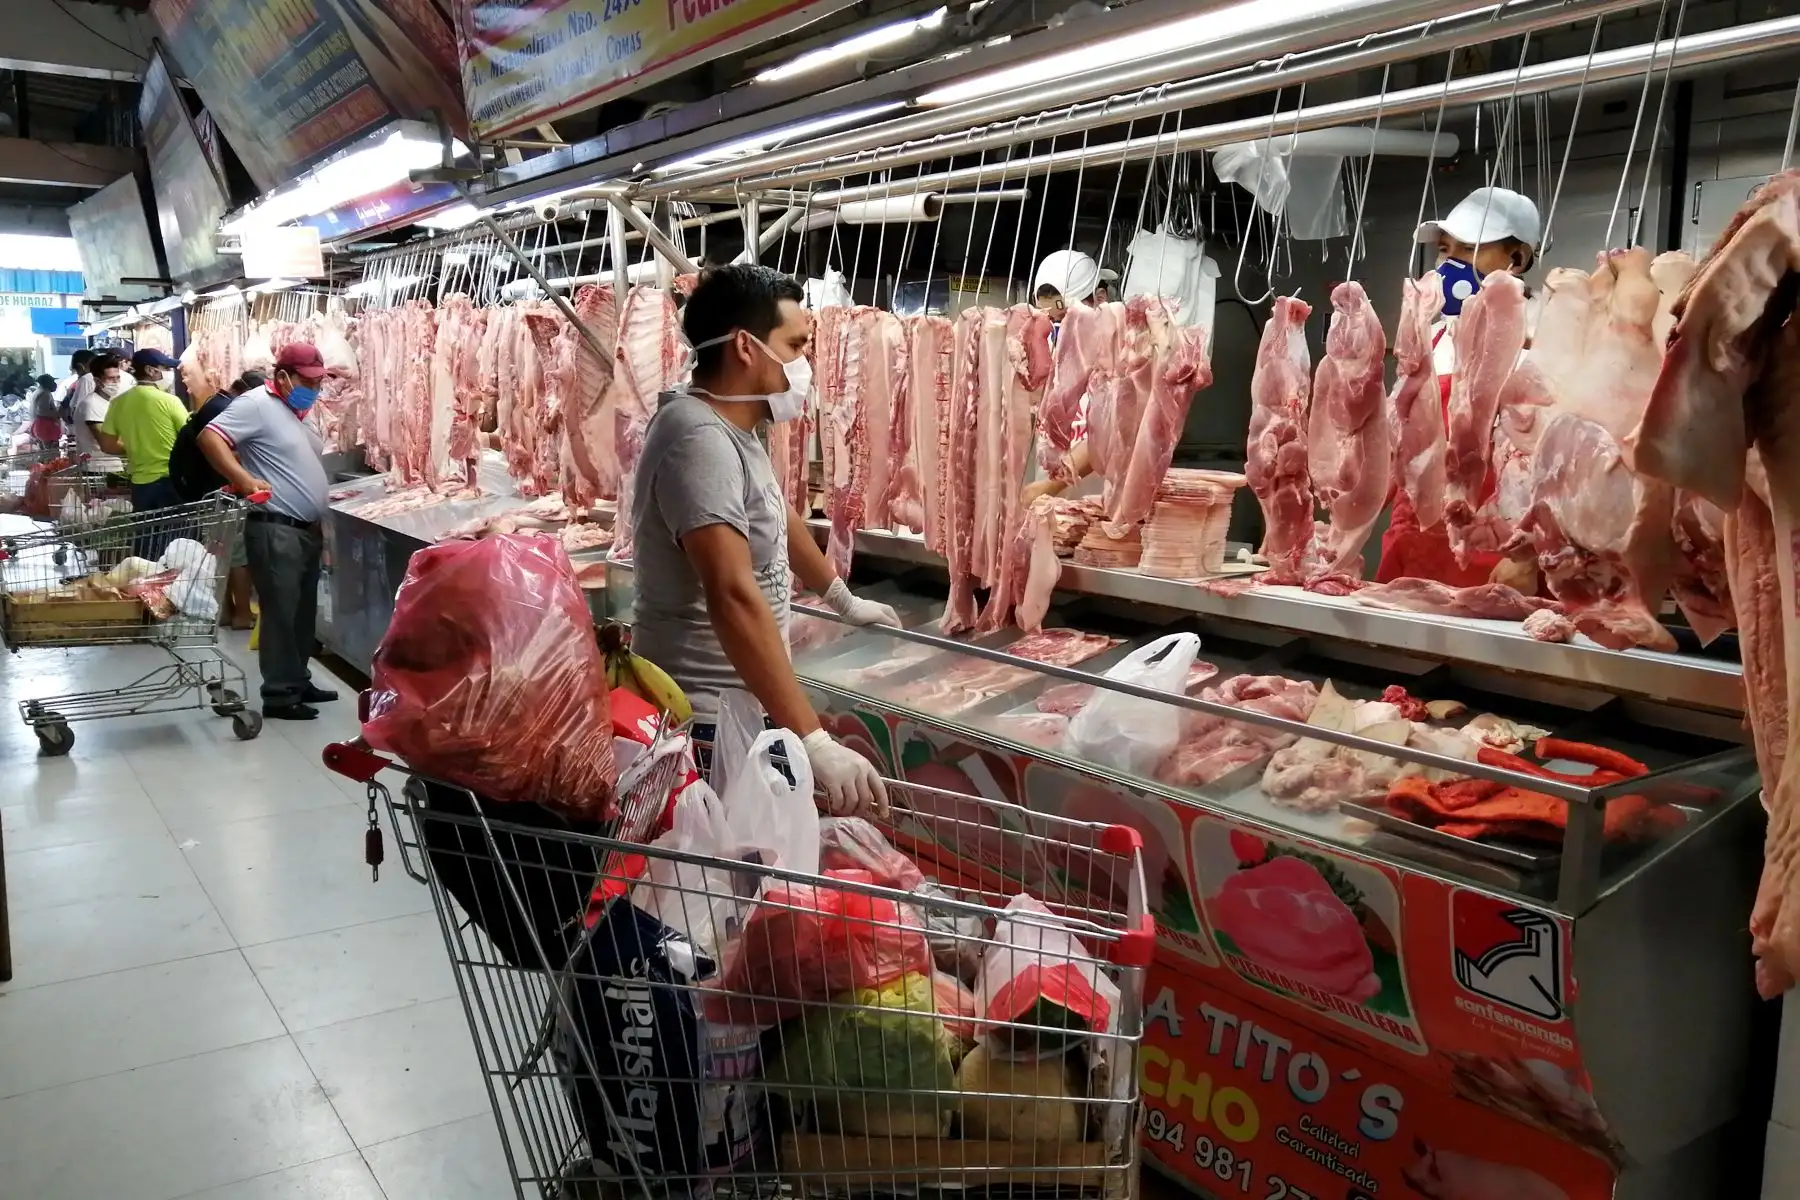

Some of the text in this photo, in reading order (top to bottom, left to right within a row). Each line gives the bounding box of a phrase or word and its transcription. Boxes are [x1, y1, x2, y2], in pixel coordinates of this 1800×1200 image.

[13, 295, 54, 307] HUARAZ
[1225, 952, 1422, 1047] PIERNA PARRILLERA
[1194, 1135, 1254, 1193] 981
[1275, 1126, 1378, 1193] Garantizada
[1299, 1114, 1361, 1158] Calidad
